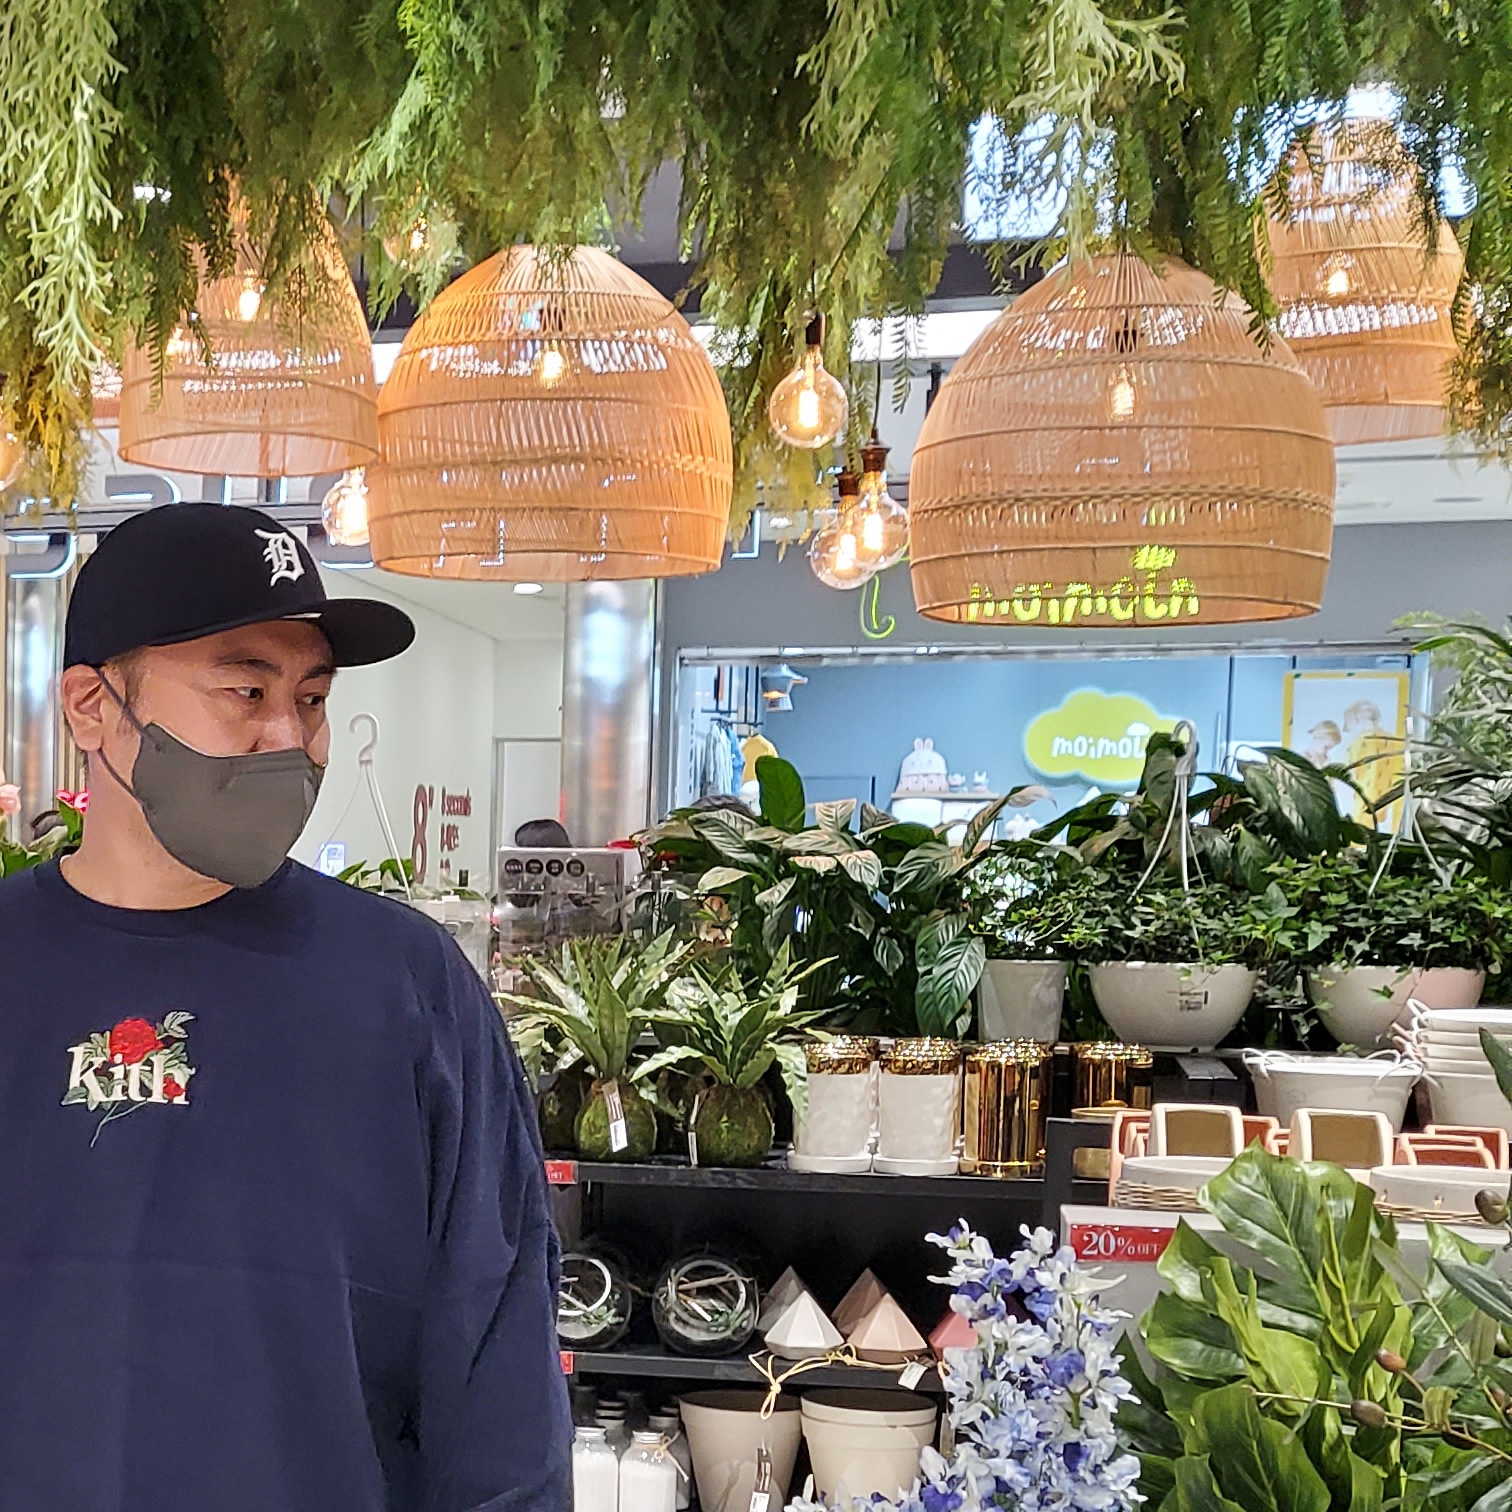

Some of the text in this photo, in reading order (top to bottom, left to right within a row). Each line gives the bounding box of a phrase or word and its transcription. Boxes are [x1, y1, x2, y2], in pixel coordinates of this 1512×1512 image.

[253, 528, 306, 587] D
[1051, 731, 1147, 759] moimol
[61, 1046, 196, 1106] Kith
[1081, 1229, 1137, 1256] 20%
